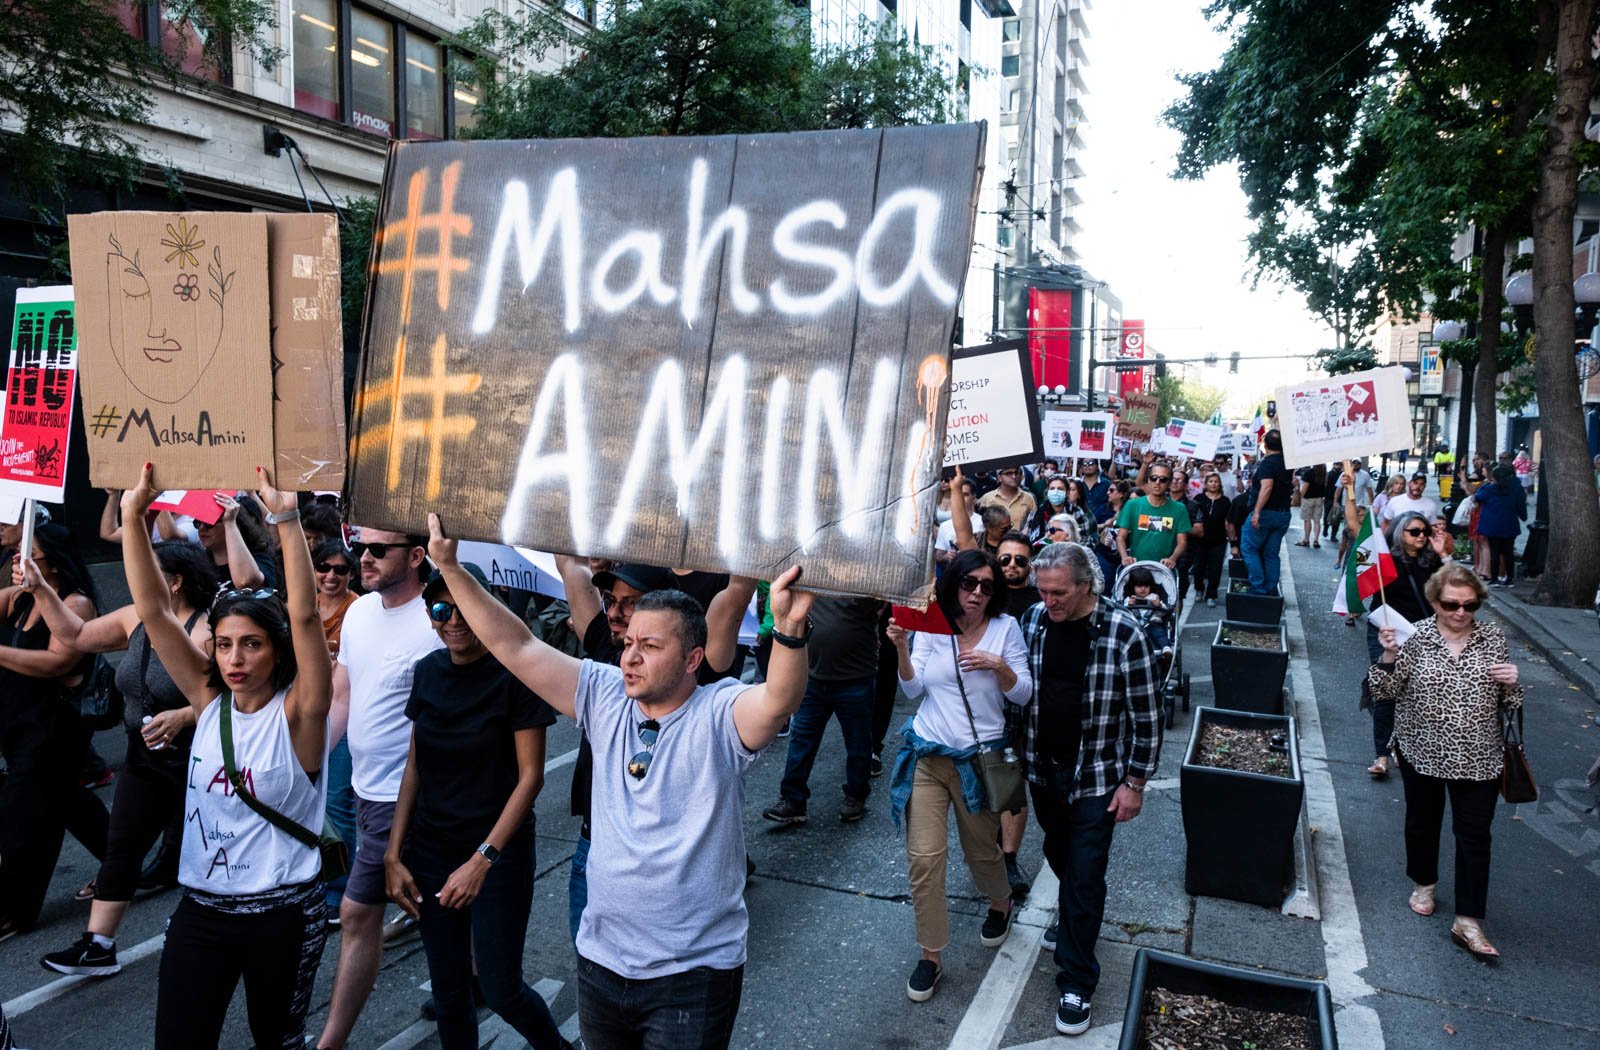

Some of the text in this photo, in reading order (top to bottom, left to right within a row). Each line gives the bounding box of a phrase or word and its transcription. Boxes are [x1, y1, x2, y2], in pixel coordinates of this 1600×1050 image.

[371, 157, 958, 335] #Mahsa
[11, 309, 74, 411] NO
[9, 410, 67, 428] TO ISLAMIC REPUBLIC
[89, 404, 246, 447] #MahsaAmini
[491, 557, 538, 592] Amini
[189, 756, 202, 789] I
[185, 807, 235, 852] Mahsa
